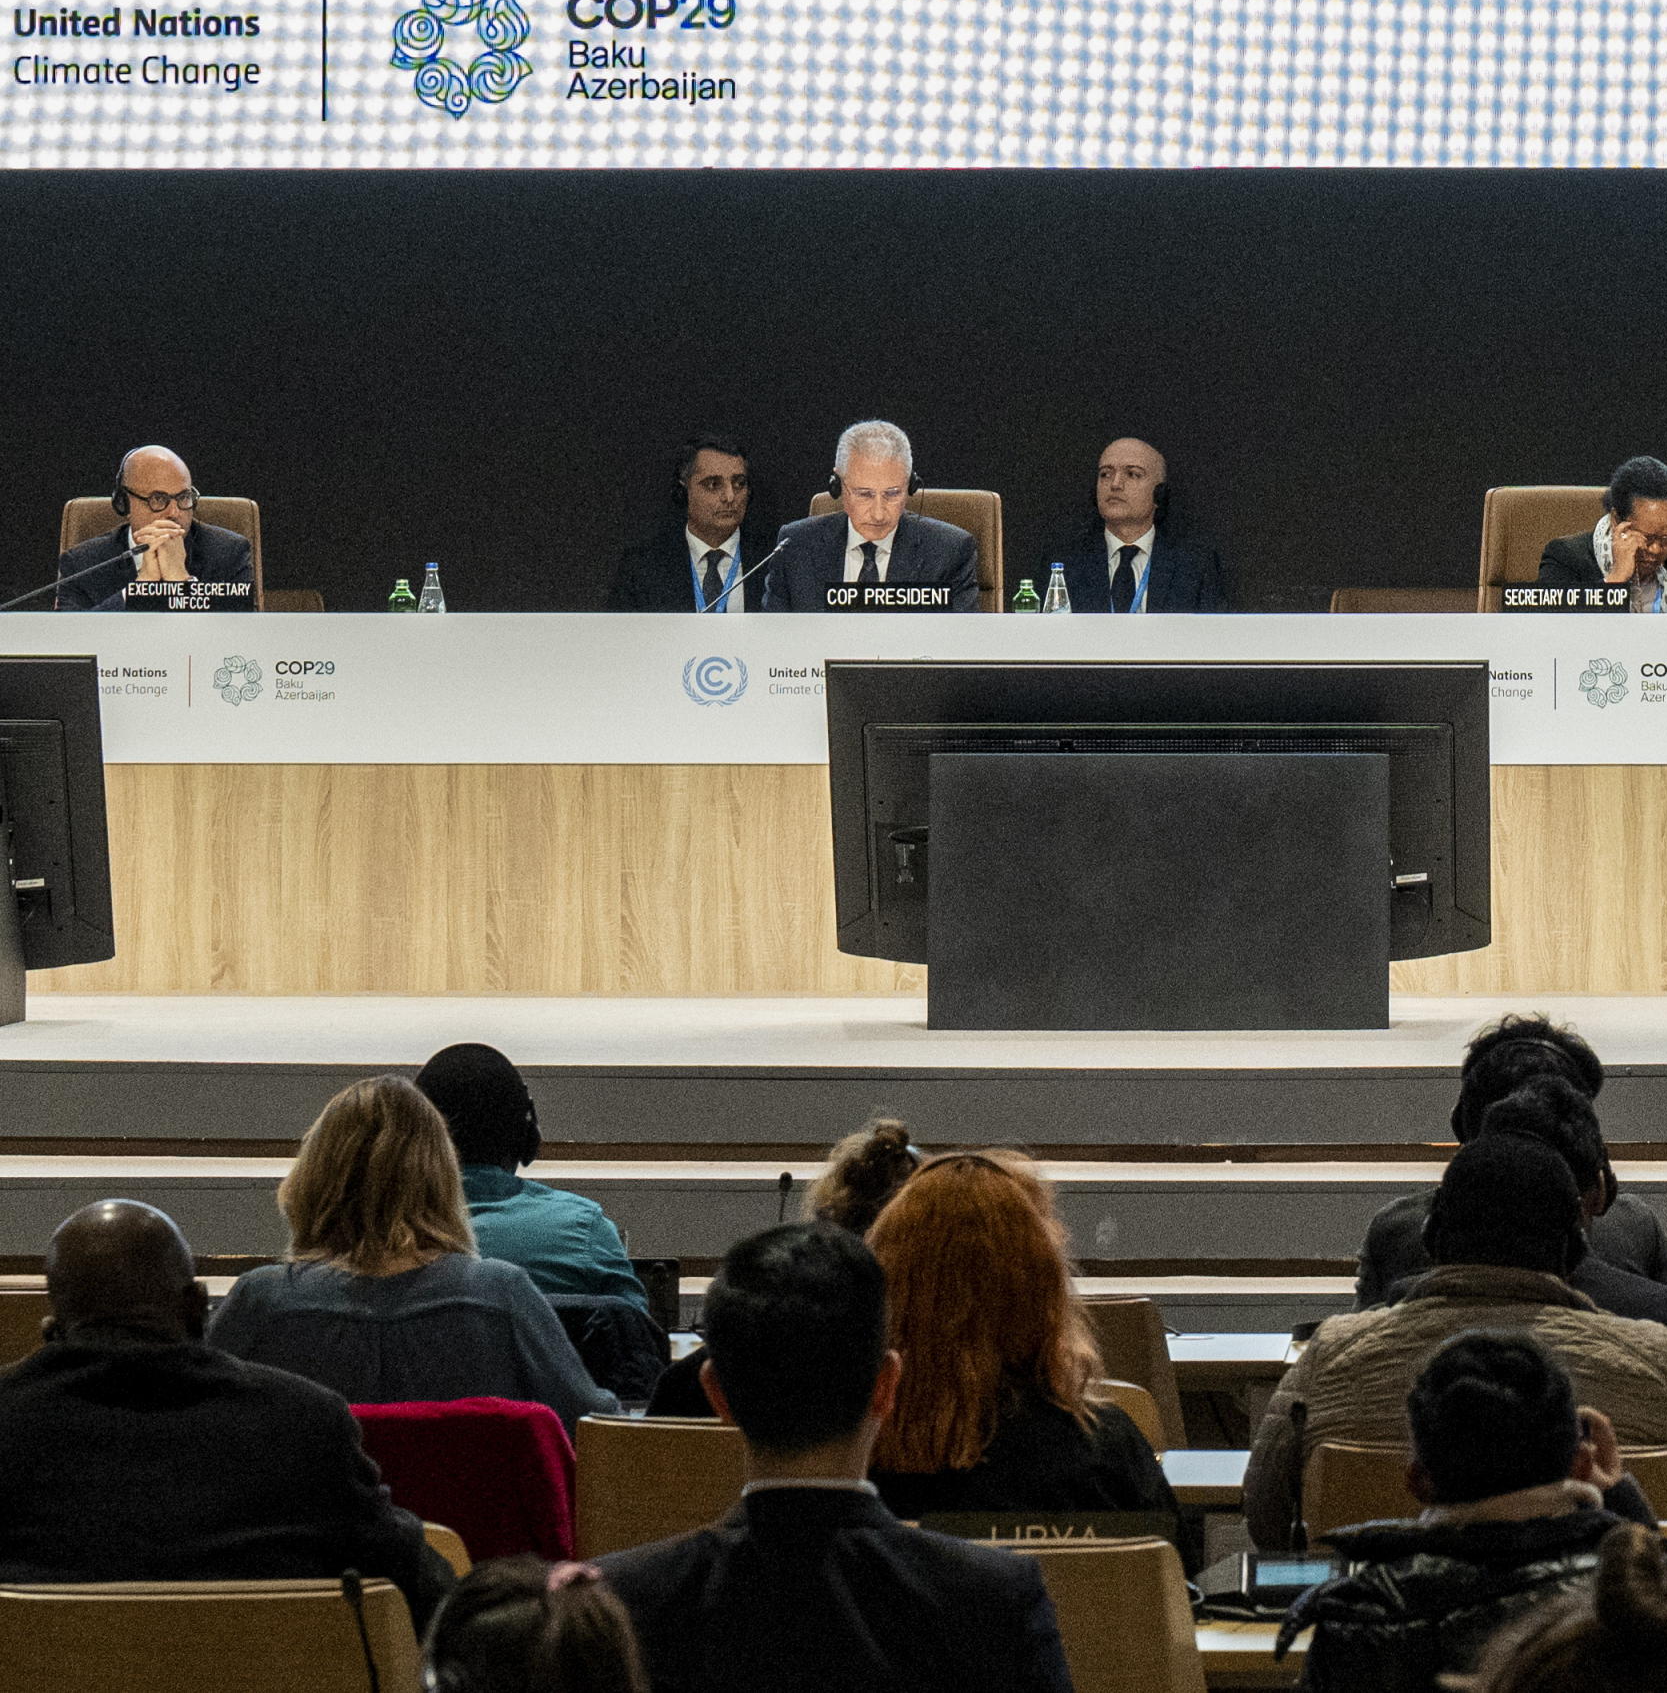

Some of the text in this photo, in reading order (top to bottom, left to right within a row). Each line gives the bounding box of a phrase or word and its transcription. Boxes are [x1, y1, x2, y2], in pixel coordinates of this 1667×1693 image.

[14, 7, 260, 37] United Nations
[568, 39, 646, 69] Baku
[13, 54, 261, 92] Climate Change
[566, 71, 736, 106] Azerbaijan
[127, 582, 251, 596] EXECUTIVE SECRETARY
[168, 596, 210, 610] UNFCCC
[826, 588, 951, 605] COP PRESIDENT
[1504, 588, 1628, 606] SECRETARY OF THE COP
[122, 667, 168, 678] Nations
[275, 661, 335, 675] COP29
[769, 667, 808, 678] United
[275, 678, 304, 689] Baku
[769, 683, 811, 695] Climate
[125, 683, 168, 699] Change
[275, 690, 336, 702] Azerbaijan
[1491, 686, 1534, 699] Change
